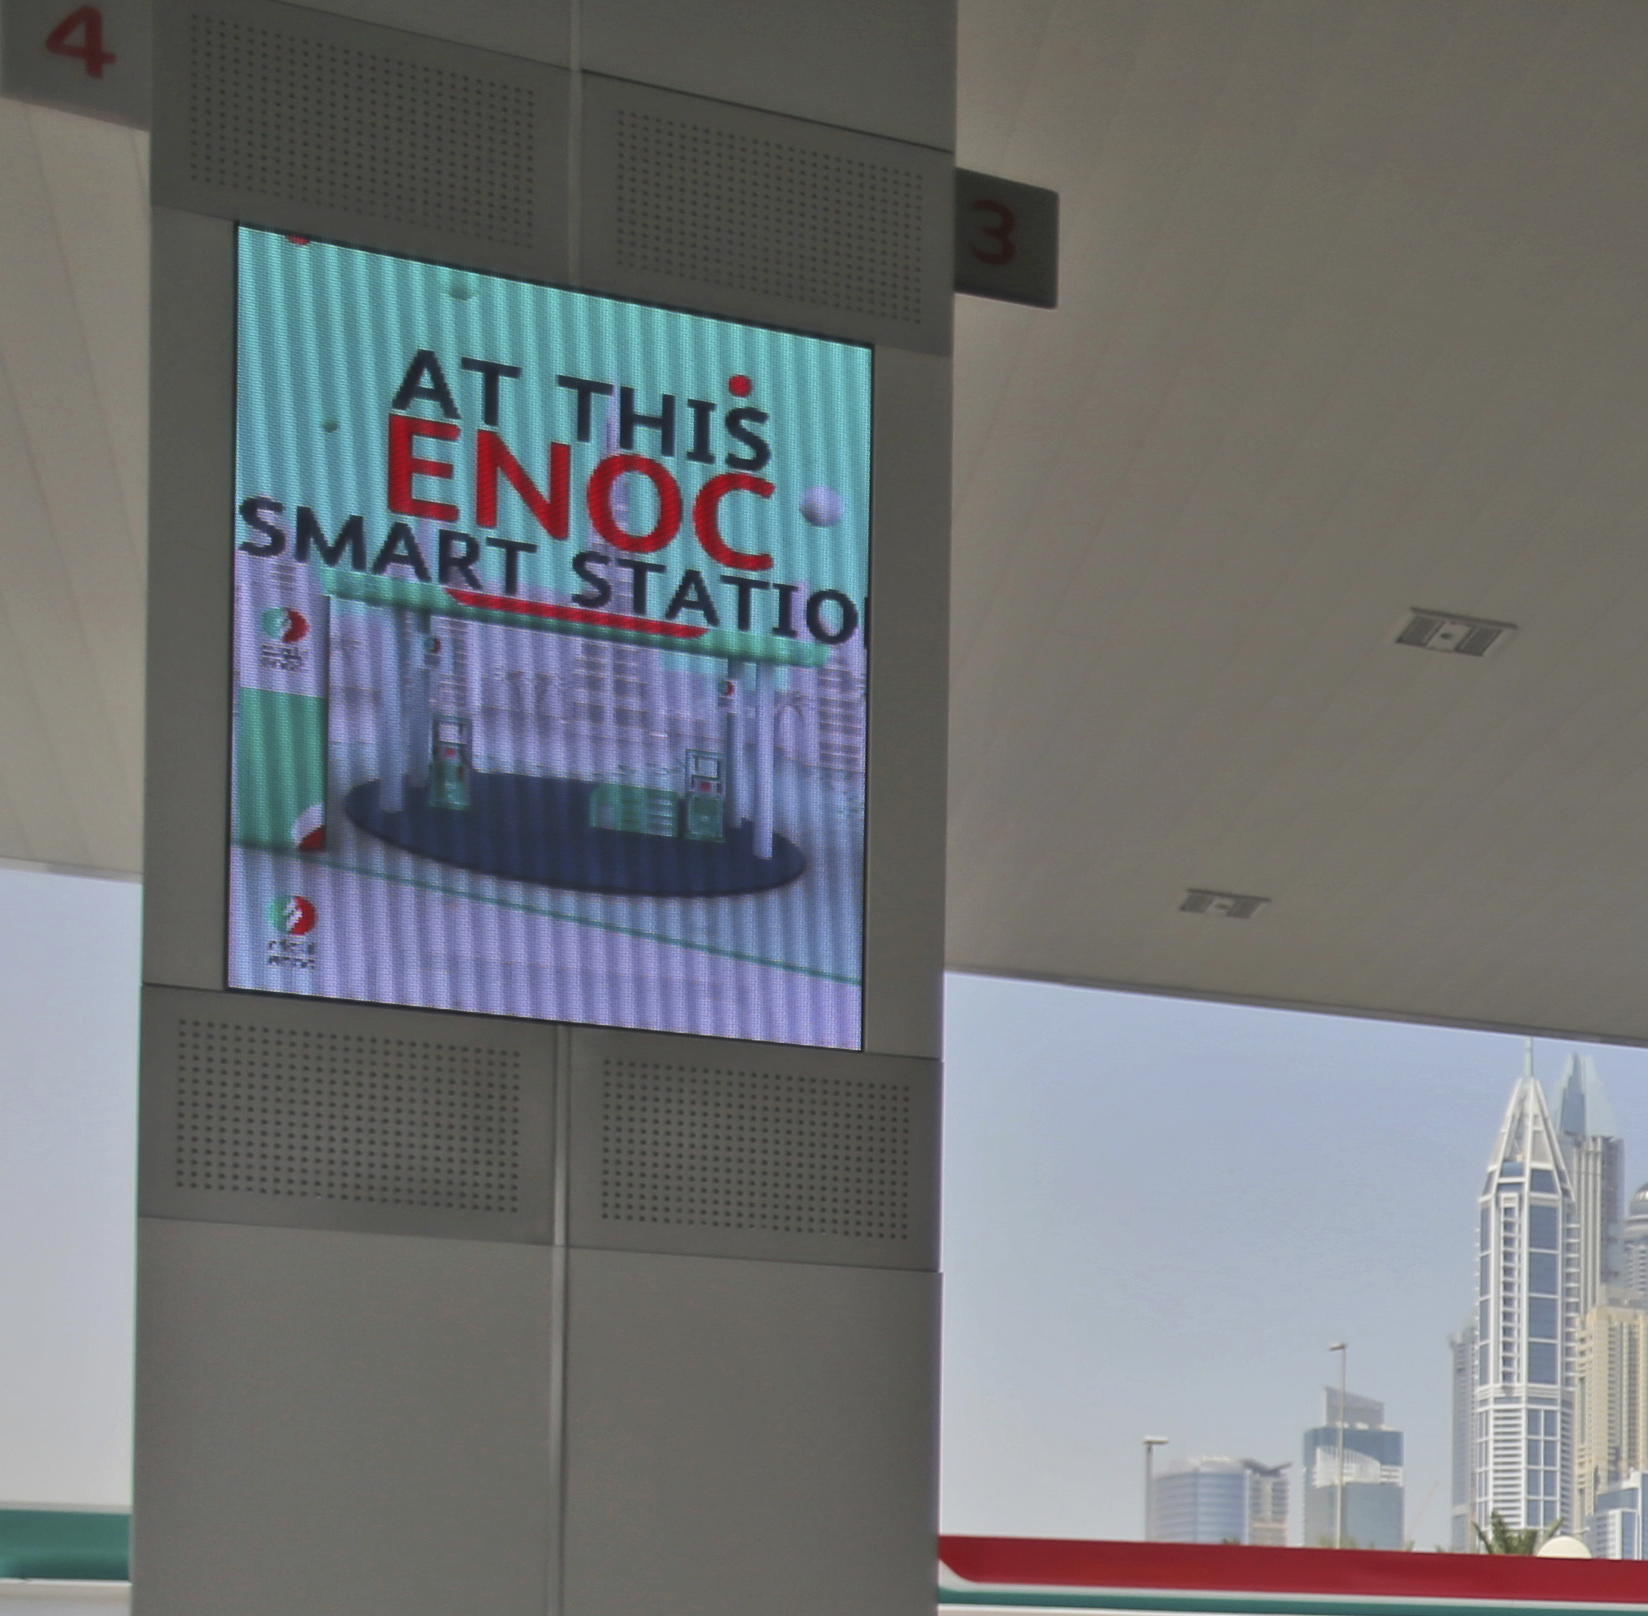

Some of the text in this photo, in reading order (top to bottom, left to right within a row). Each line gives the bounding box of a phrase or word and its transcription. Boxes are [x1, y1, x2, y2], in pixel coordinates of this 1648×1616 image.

[45, 5, 116, 79] 4
[968, 199, 1016, 267] 3
[391, 349, 772, 472] AT THIS
[387, 412, 776, 572] ENOC
[238, 495, 869, 646] SMART STATIO
